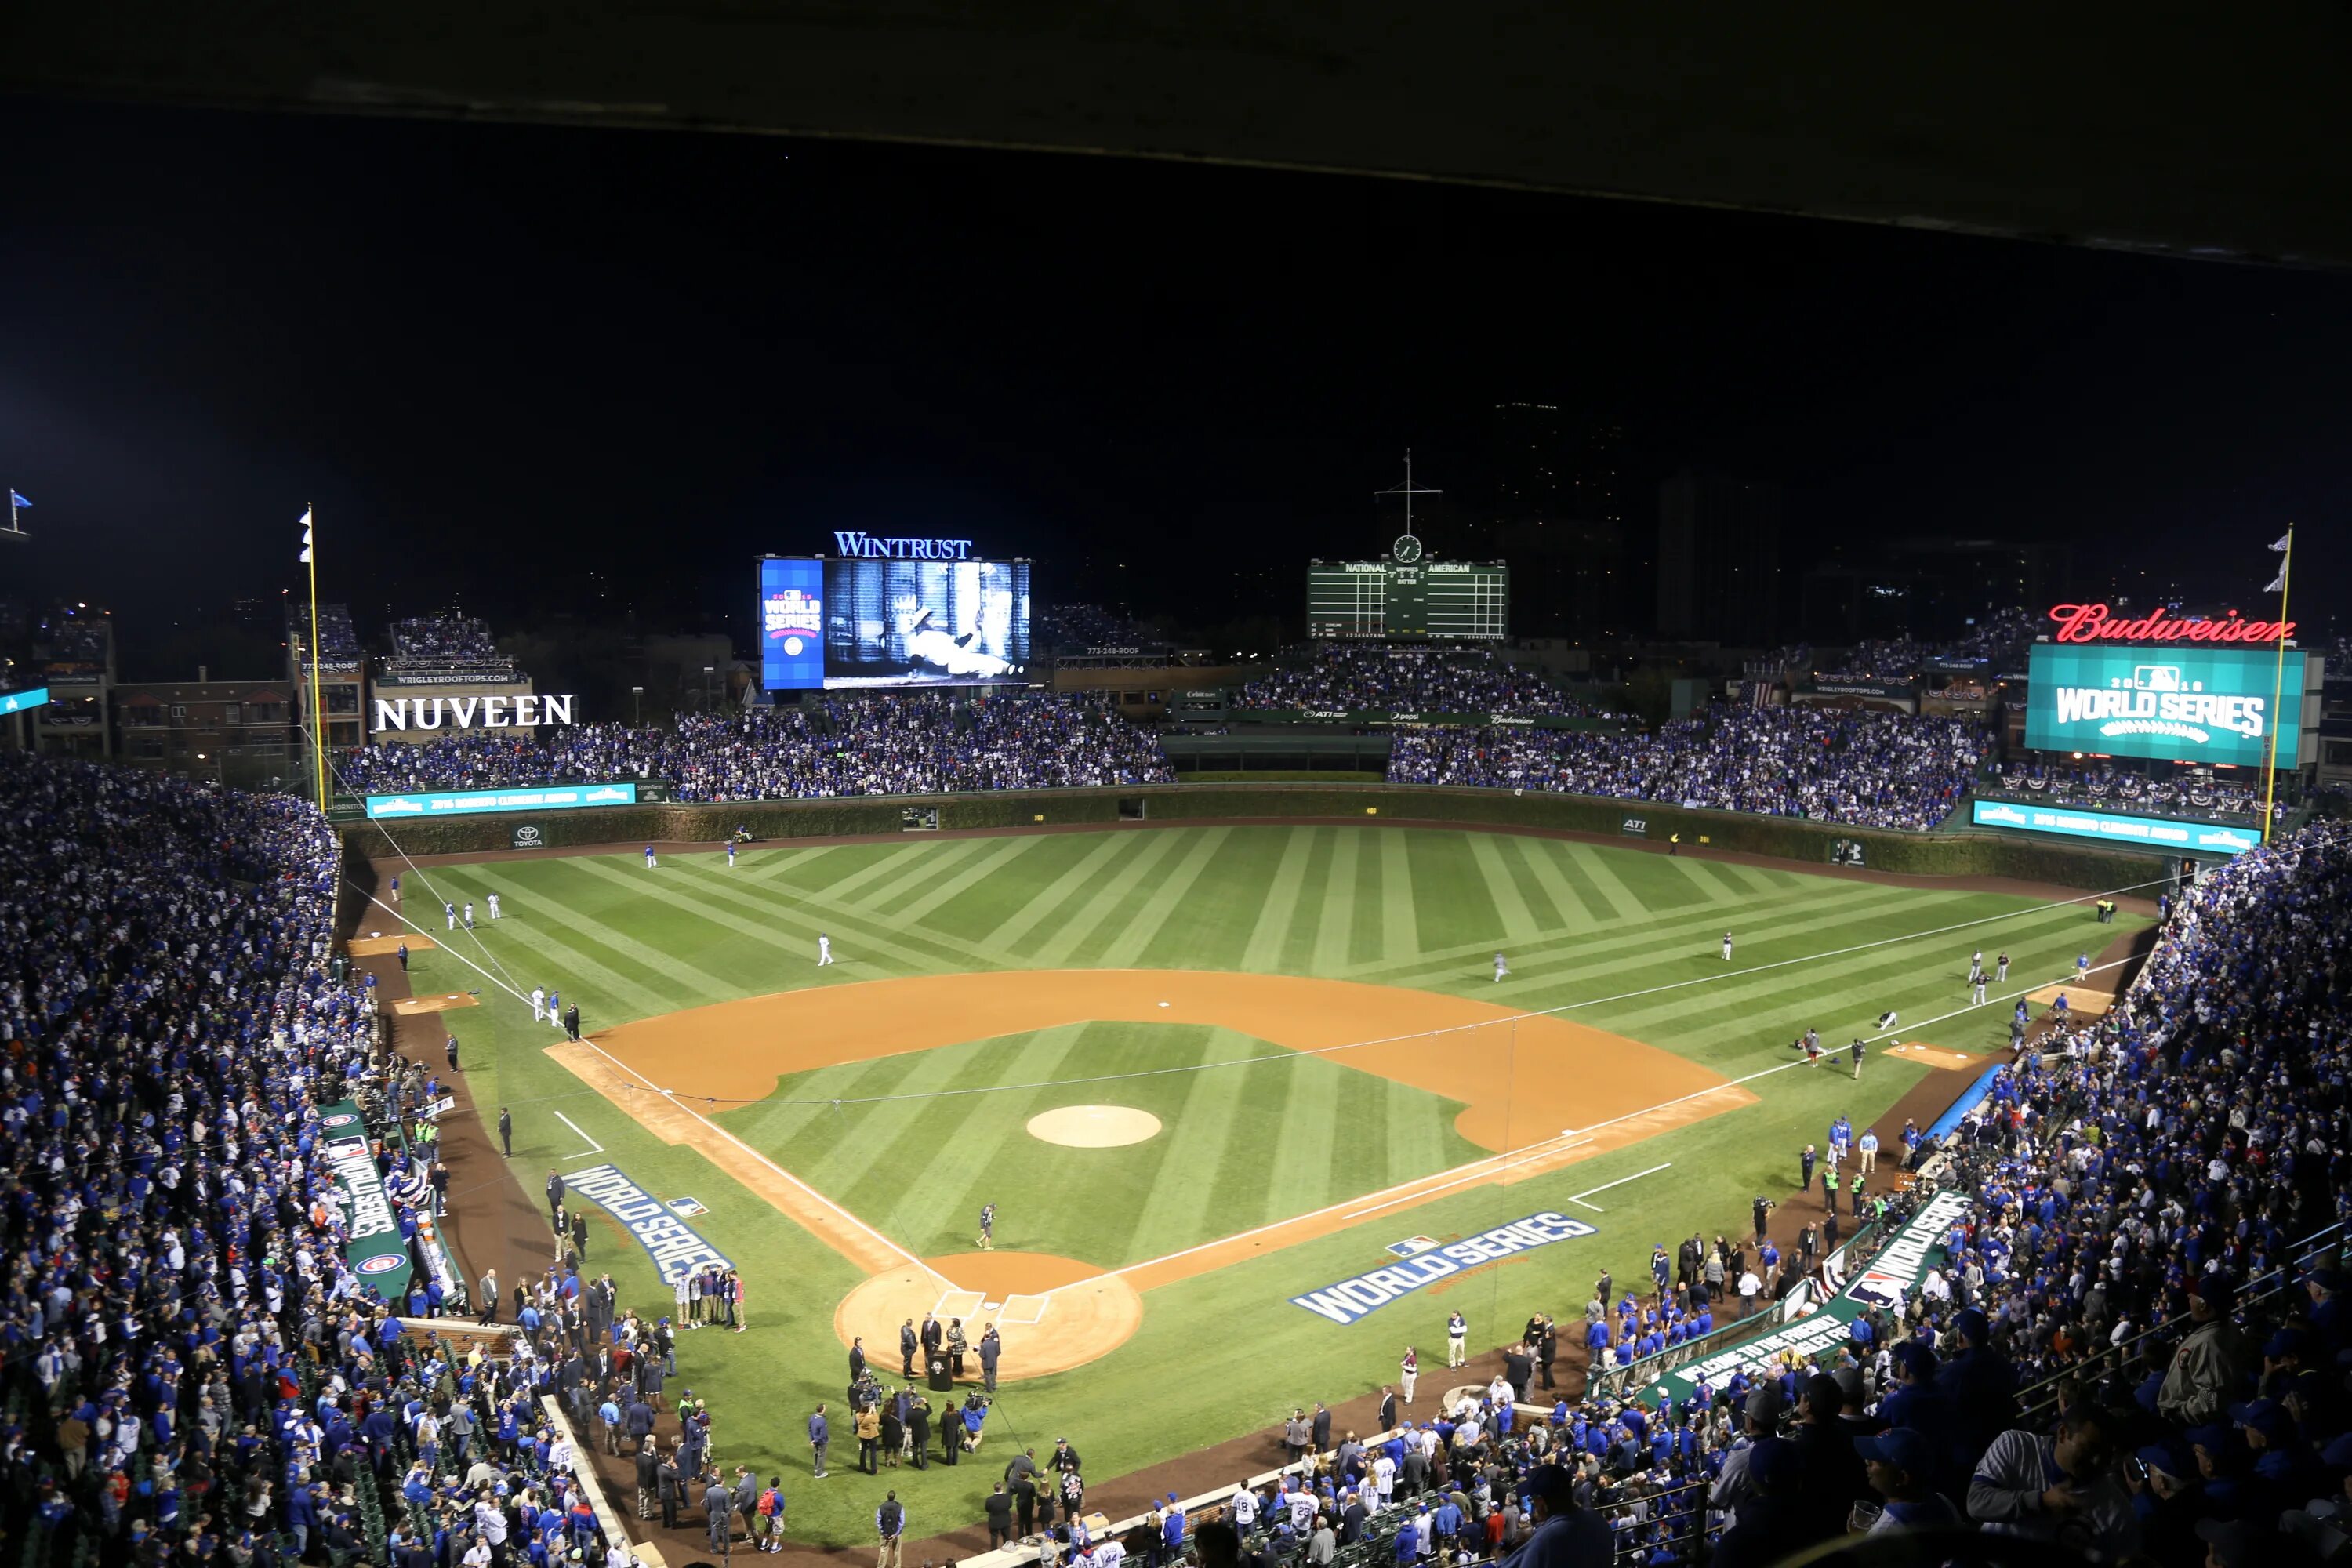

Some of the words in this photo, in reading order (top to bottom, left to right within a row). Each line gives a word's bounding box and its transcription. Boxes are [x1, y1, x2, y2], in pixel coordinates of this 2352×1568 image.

[834, 532, 971, 559] WINTRUST
[1345, 564, 1387, 572] NATIONAL
[1428, 564, 1470, 573] AMERICAN
[765, 600, 821, 614] WORLD
[765, 614, 821, 633] SERIES
[2049, 604, 2296, 643] Budweiser
[398, 675, 509, 684] WRIGLEYROOFTOPS.COM
[1817, 685, 1885, 695] WRIGLEYROOFTOPS.COM
[375, 695, 573, 731] NUVEEN
[1490, 714, 1535, 724] Budweiser
[2056, 688, 2157, 724] WORLD
[2160, 694, 2264, 738] SERIES
[1623, 819, 1646, 829] ATI
[331, 1154, 382, 1195] WORLD
[561, 1164, 663, 1221] WORLD
[350, 1192, 395, 1239] SERIES
[1869, 1228, 1936, 1279] WORLD
[1911, 1192, 1973, 1233] SERIES
[1293, 1254, 1460, 1323] WORLD
[1442, 1212, 1598, 1265] SERIES
[1674, 1351, 1749, 1383] WELCOME
[1736, 1344, 1765, 1358] TO
[1753, 1335, 1791, 1352] THE
[1778, 1314, 1842, 1343] FRIENDLY
[560, 1450, 571, 1463] 12
[1381, 1468, 1392, 1478] 44
[1236, 1501, 1248, 1512] 18
[1298, 1506, 1310, 1517] 23
[1105, 1555, 1117, 1563] 44
